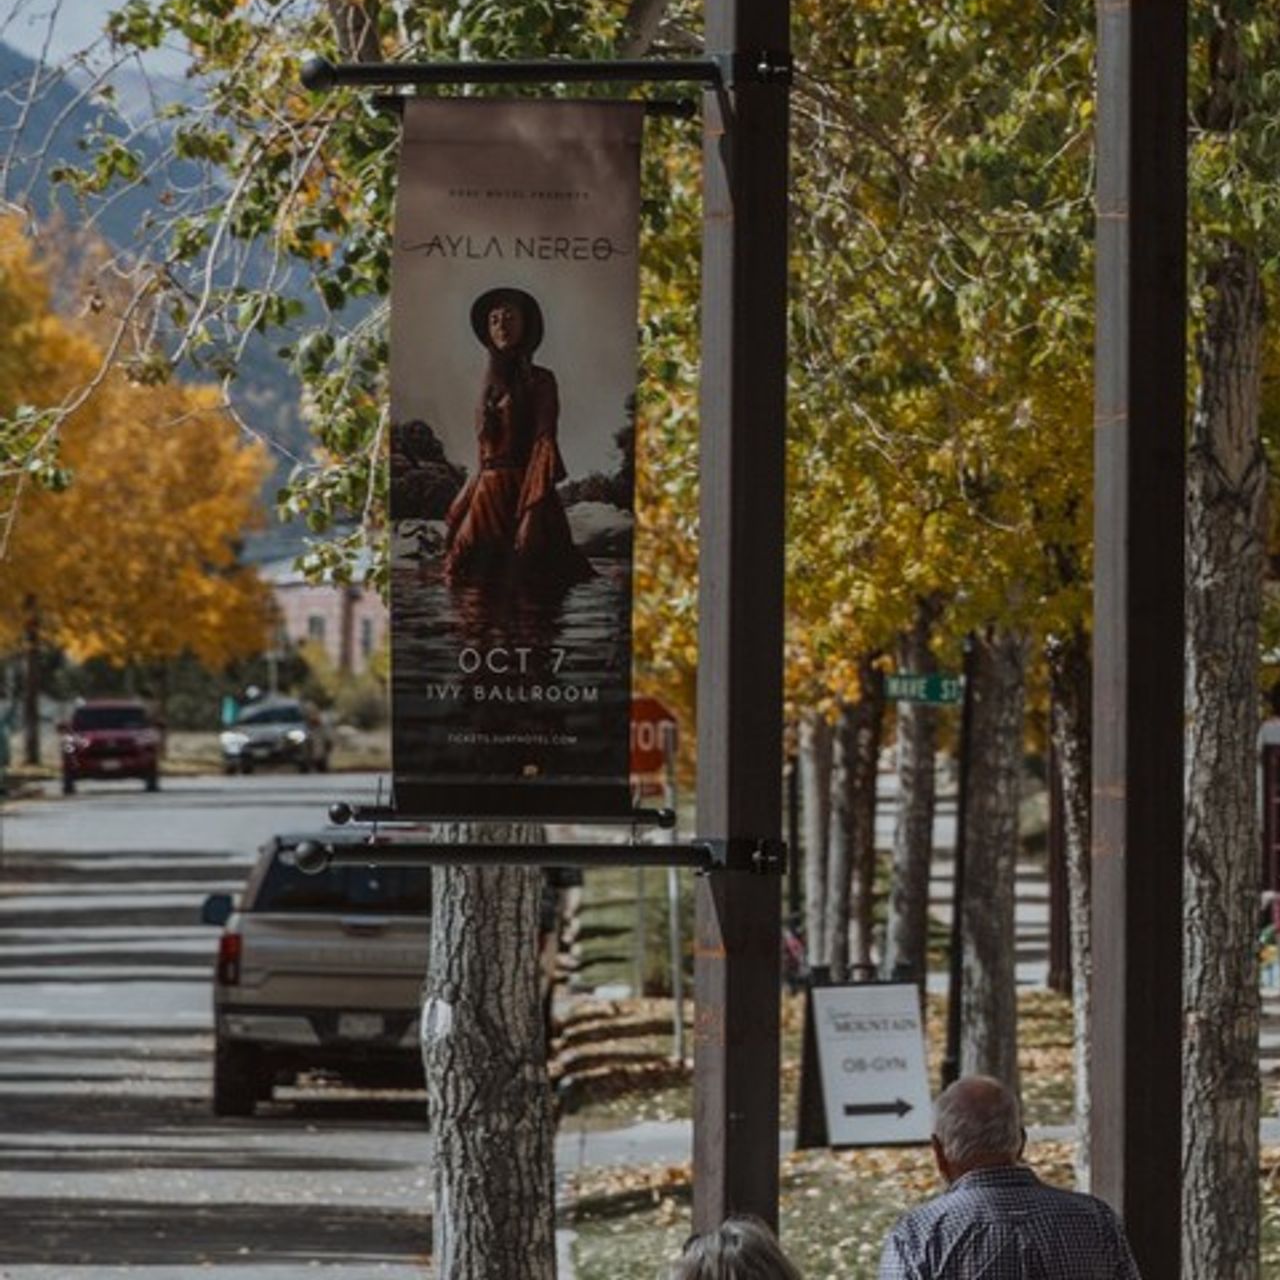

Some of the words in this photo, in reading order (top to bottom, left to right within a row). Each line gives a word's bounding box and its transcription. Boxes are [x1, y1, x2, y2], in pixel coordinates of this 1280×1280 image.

[424, 234, 504, 259] AYLA
[514, 236, 614, 261] NEREO
[458, 647, 532, 674] OCT
[550, 648, 567, 673] 7
[426, 684, 464, 701] IVY
[473, 684, 600, 703] BALLROOM
[842, 1056, 908, 1073] OB-GYN
